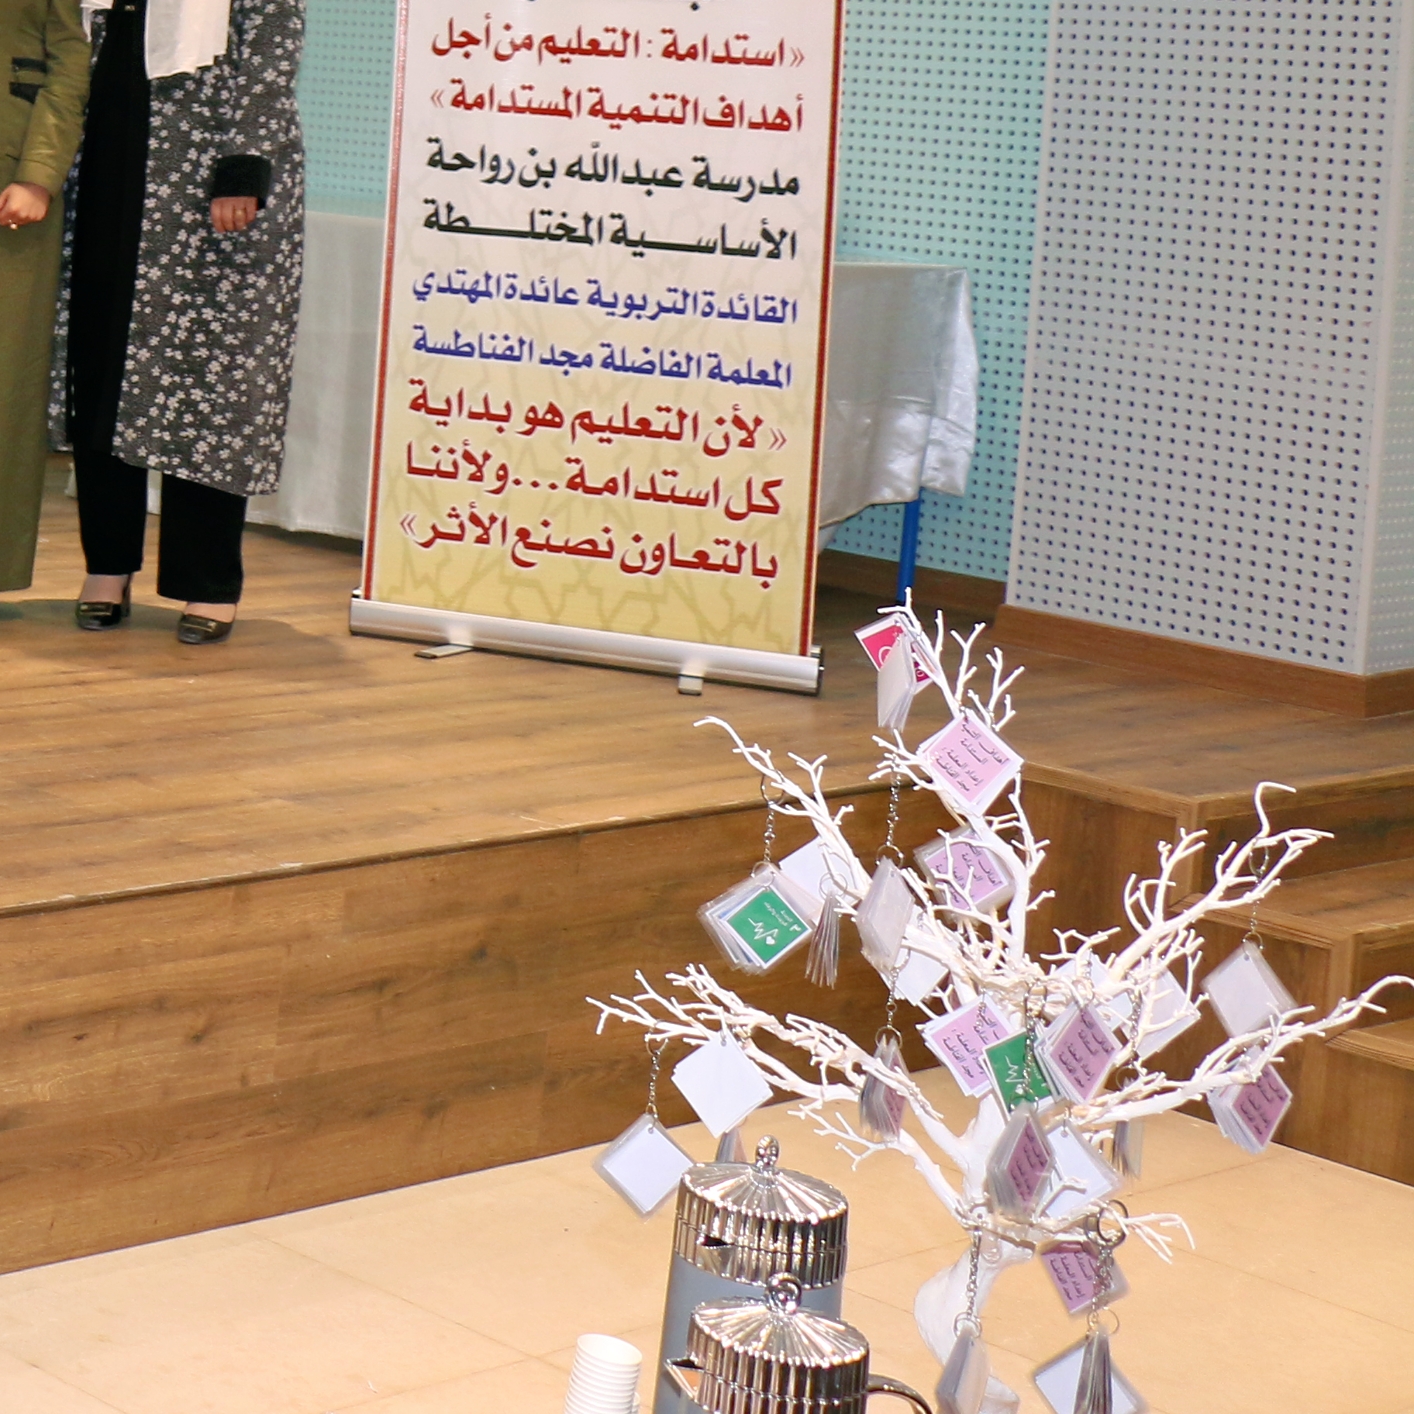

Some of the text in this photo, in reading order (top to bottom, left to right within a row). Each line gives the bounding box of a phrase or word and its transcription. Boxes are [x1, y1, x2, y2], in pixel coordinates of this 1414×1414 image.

[431, 13, 492, 61] أجل
[494, 23, 533, 62] من
[537, 25, 640, 63] التعليم
[588, 87, 699, 131] التنمية
[706, 94, 804, 132] أهداف
[427, 137, 515, 186] رواحة
[520, 147, 557, 189] بن
[693, 160, 800, 202] مدرسة
[412, 268, 798, 324] القائدة التربوية عائدة المهتدي
[412, 324, 792, 388] المعلمة الفاضلة مجد الفناطسة
[408, 378, 513, 436] بداية
[517, 401, 565, 436] هو
[572, 401, 699, 444] التعليم
[724, 477, 783, 520] كل
[511, 518, 614, 568] نصنع
[619, 532, 778, 589] بالتعاون
[960, 737, 988, 765] المستدامة
[978, 741, 1009, 765] أهداف
